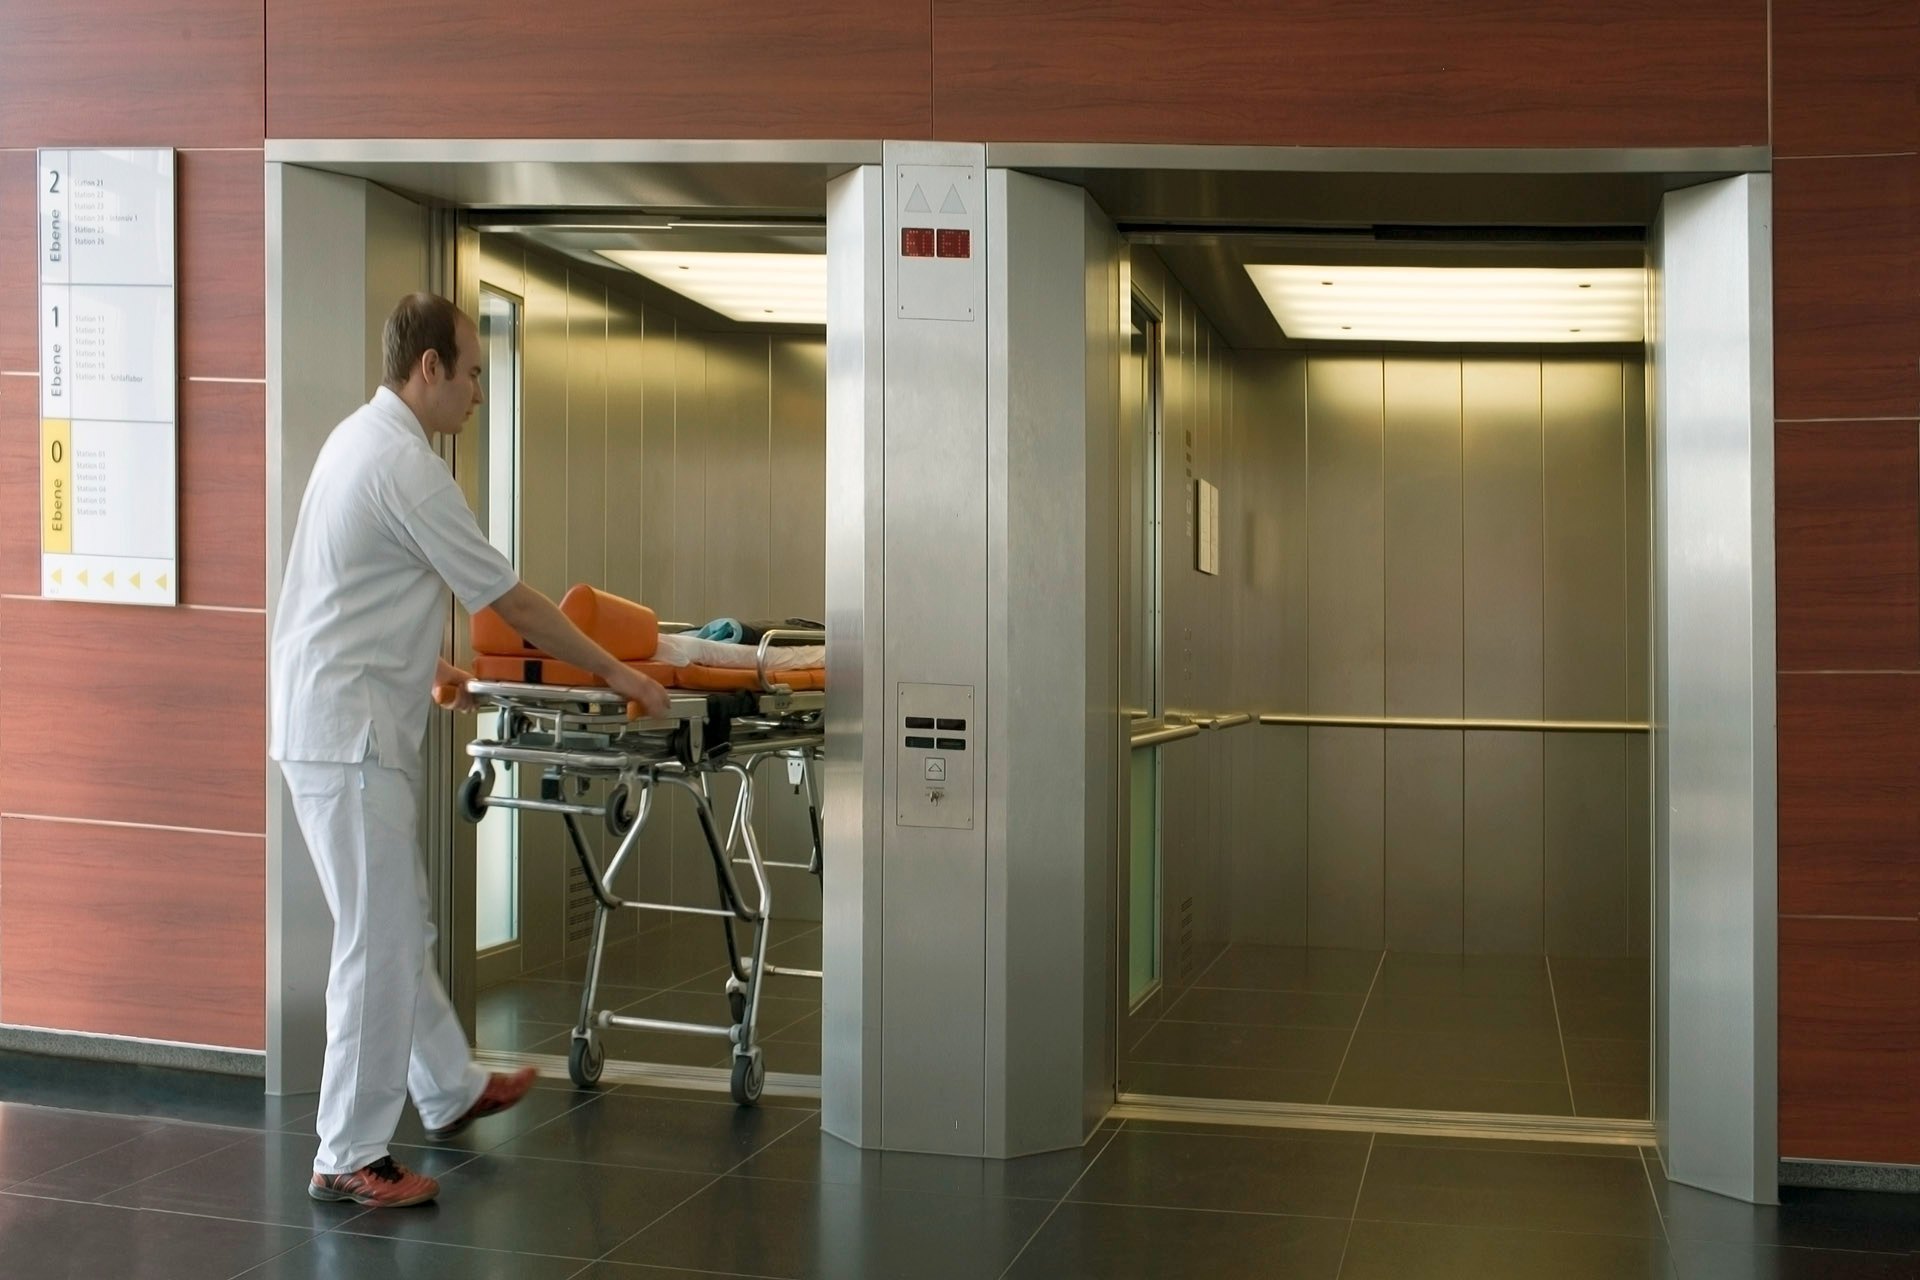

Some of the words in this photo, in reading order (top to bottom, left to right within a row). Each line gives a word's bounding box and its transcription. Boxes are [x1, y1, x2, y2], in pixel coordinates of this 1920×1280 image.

[49, 170, 60, 193] 2
[49, 209, 61, 262] Ebene
[52, 305, 59, 328] 1
[51, 344, 62, 397] Ebene
[52, 440, 62, 463] 0
[52, 479, 62, 531] Ebene
